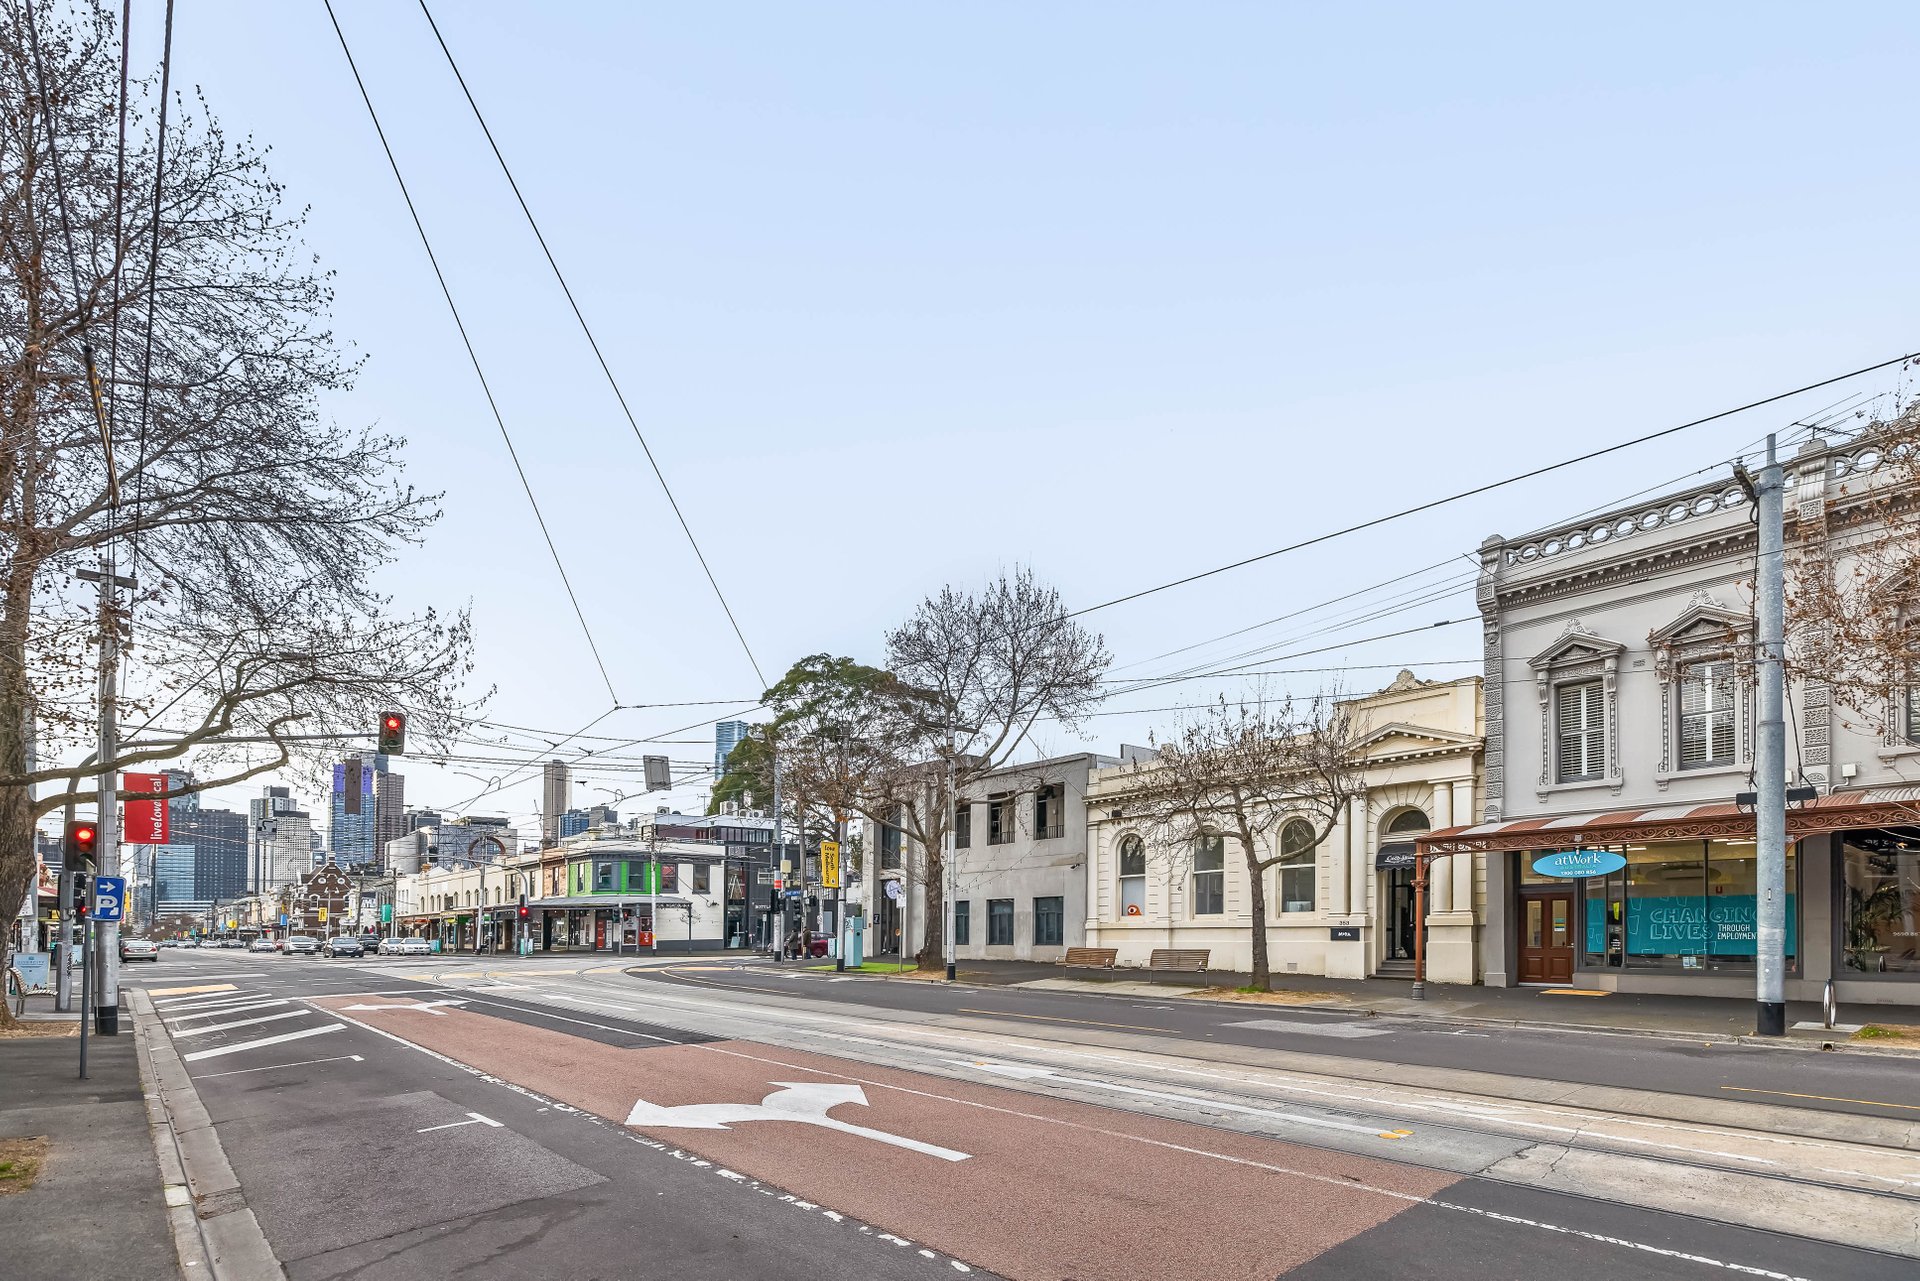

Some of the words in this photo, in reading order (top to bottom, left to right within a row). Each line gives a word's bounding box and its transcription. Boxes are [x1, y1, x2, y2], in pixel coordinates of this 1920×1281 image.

[1554, 853, 1602, 866] atWork
[1650, 924, 1714, 940] LIVES
[1717, 923, 1751, 932] THROUGH
